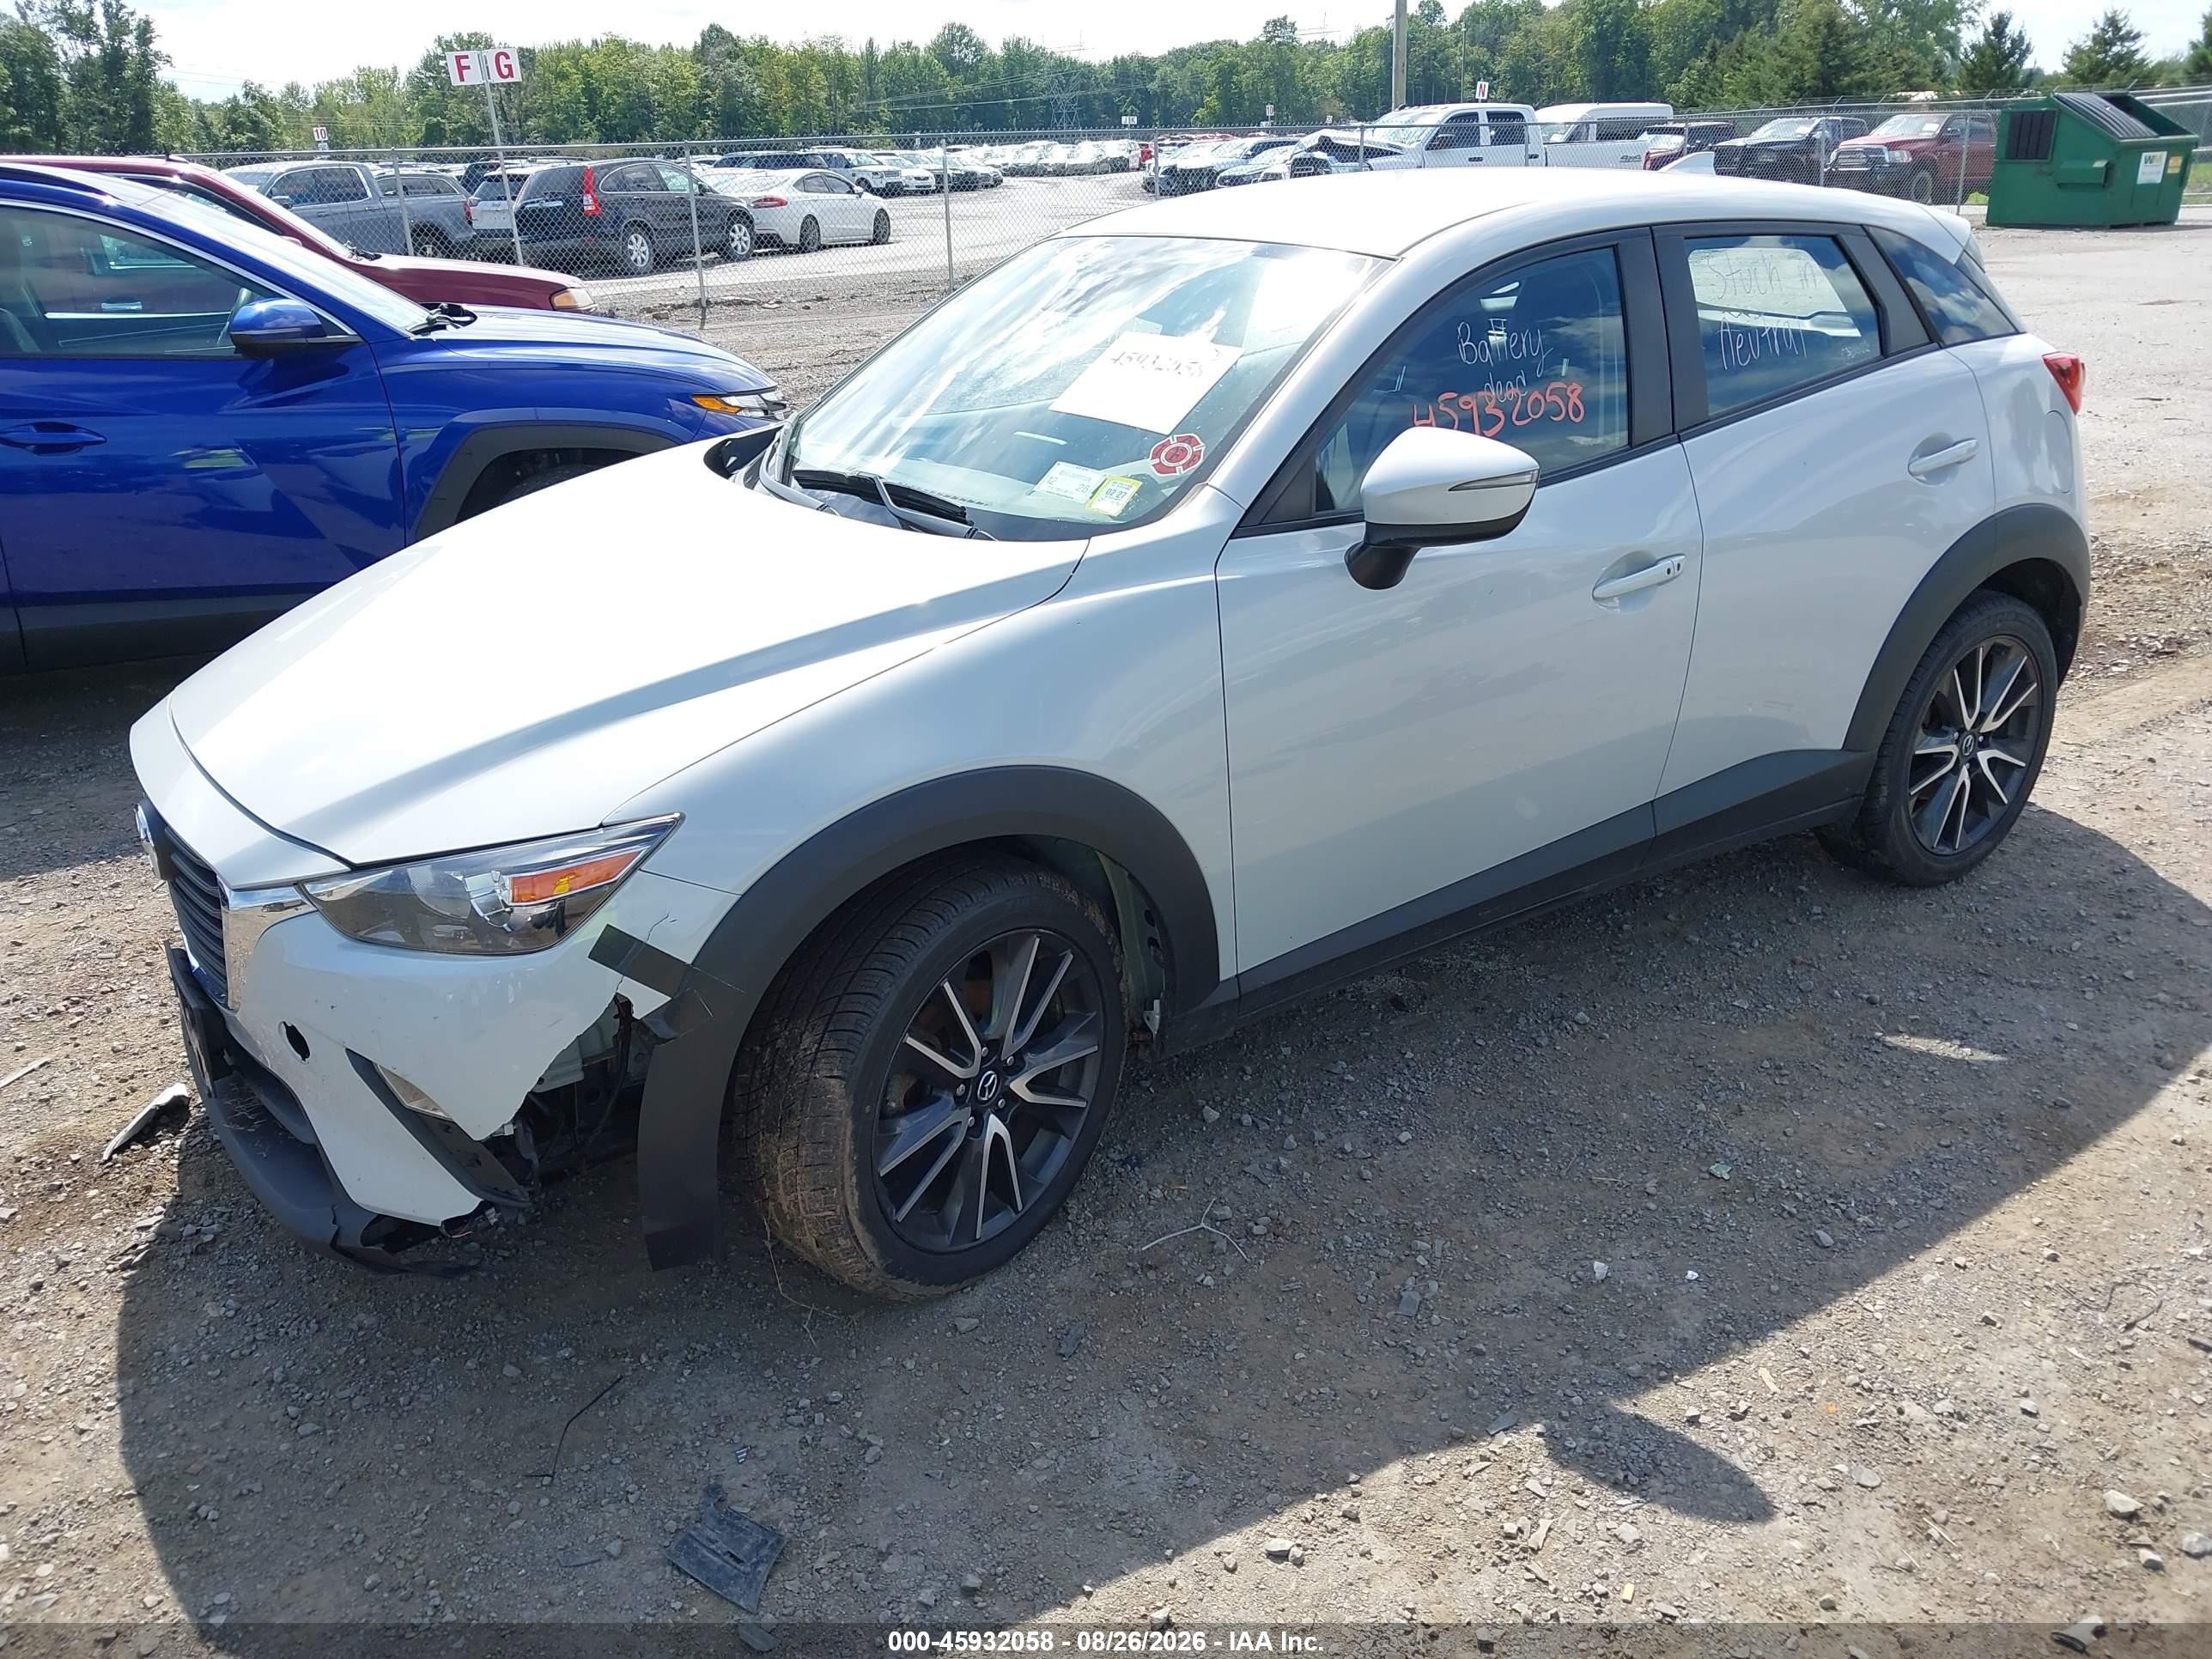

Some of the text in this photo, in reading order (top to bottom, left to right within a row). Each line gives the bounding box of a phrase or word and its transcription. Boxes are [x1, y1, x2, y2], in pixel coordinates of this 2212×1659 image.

[454, 51, 514, 82] F G
[1478, 83, 1486, 97] N
[1267, 106, 1273, 114] 10
[314, 128, 326, 140] 10
[1413, 381, 1586, 439] 45932058
